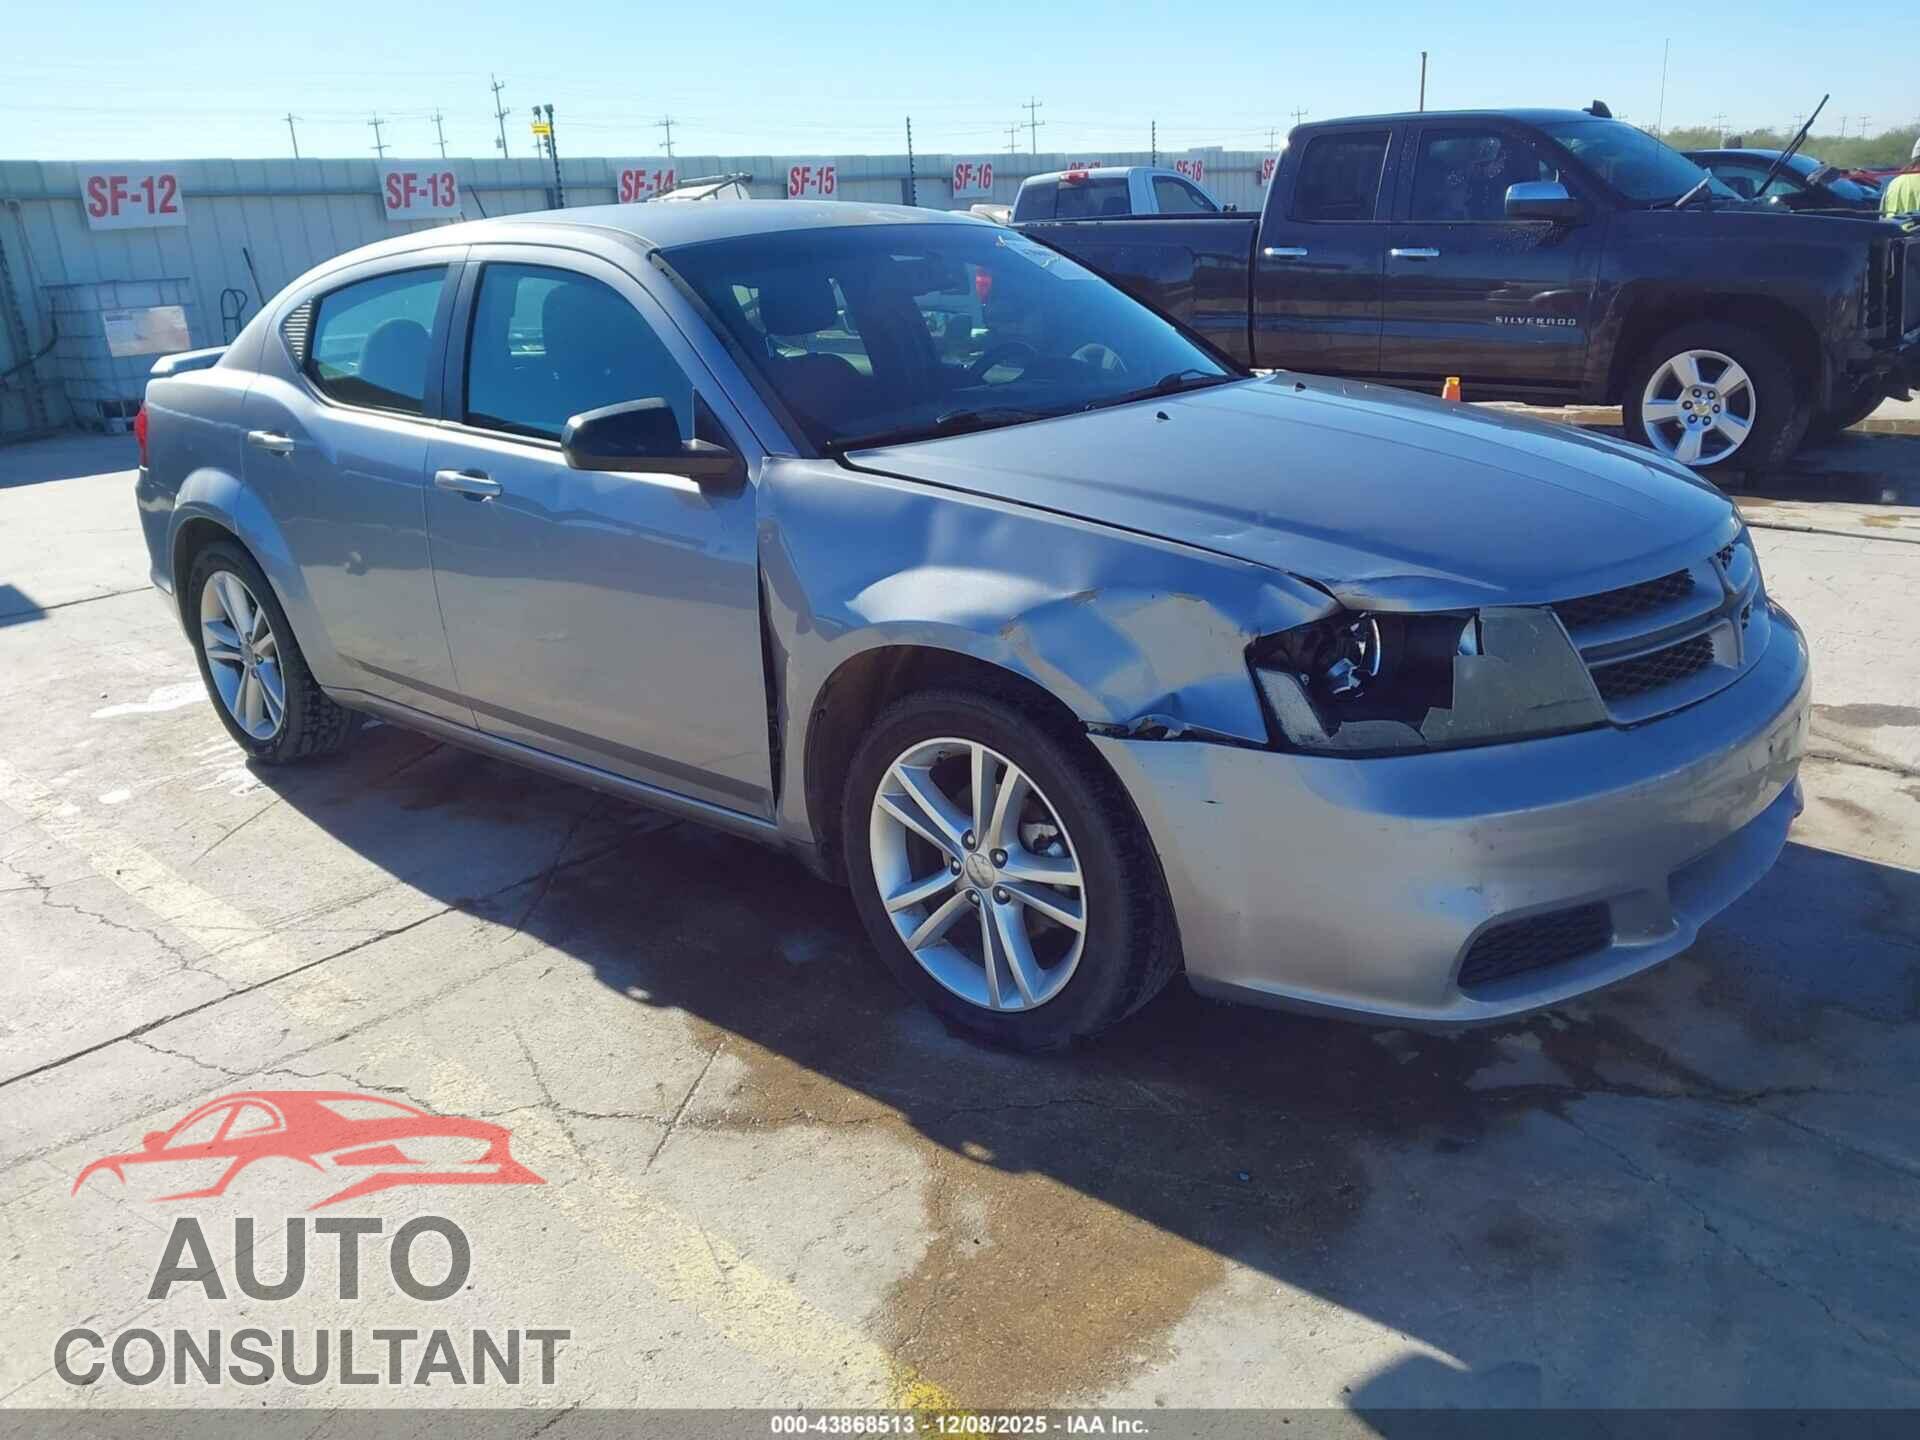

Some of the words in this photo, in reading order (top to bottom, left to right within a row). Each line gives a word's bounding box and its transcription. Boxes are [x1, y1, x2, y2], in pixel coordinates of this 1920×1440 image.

[385, 172, 456, 210] SF-13
[620, 169, 675, 202] SF-14
[788, 165, 835, 197] SF-15
[954, 162, 994, 192] SF-16
[86, 174, 178, 218] SF-12
[1495, 315, 1577, 327] SILVERADO
